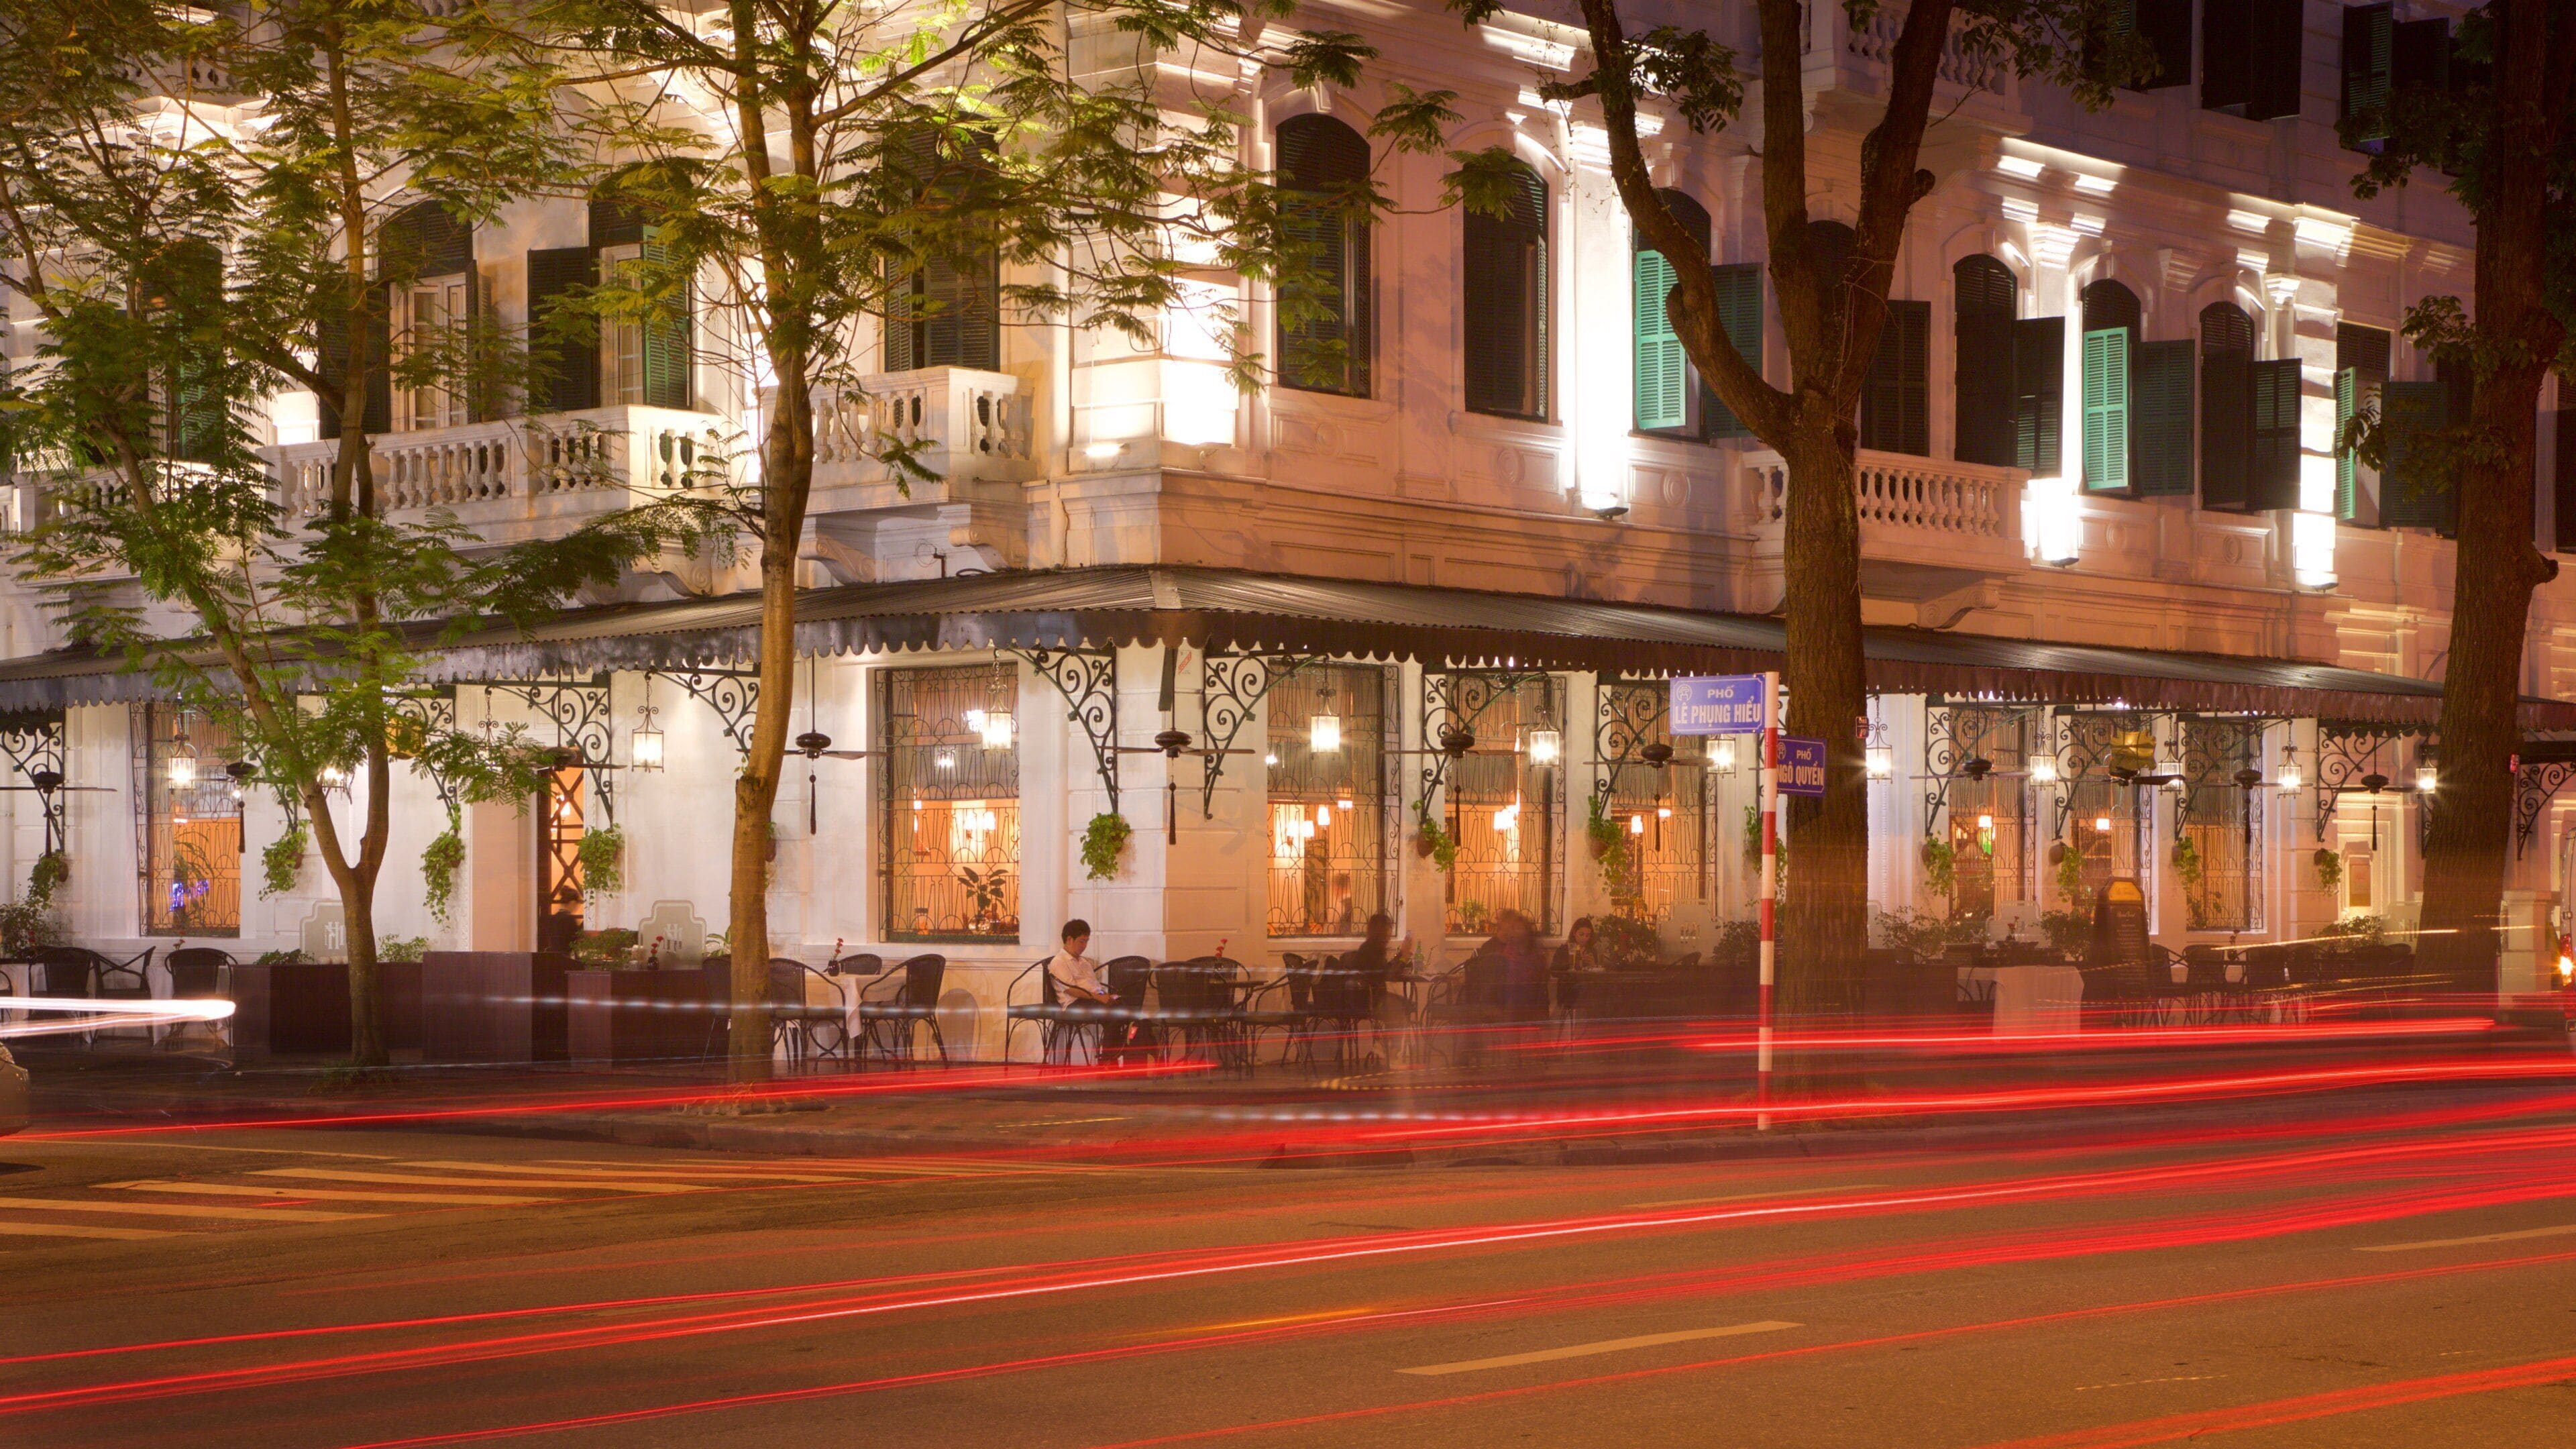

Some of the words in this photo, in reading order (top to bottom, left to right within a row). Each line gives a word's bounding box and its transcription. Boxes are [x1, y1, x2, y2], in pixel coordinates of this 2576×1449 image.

[1707, 685, 1735, 698] PHỐ
[1674, 702, 1687, 724] LÊ
[1691, 704, 1730, 727] PHỤNG
[1734, 696, 1761, 722] HIỂU
[1796, 747, 1812, 760] PHỐ
[1777, 761, 1793, 784] NGÔ
